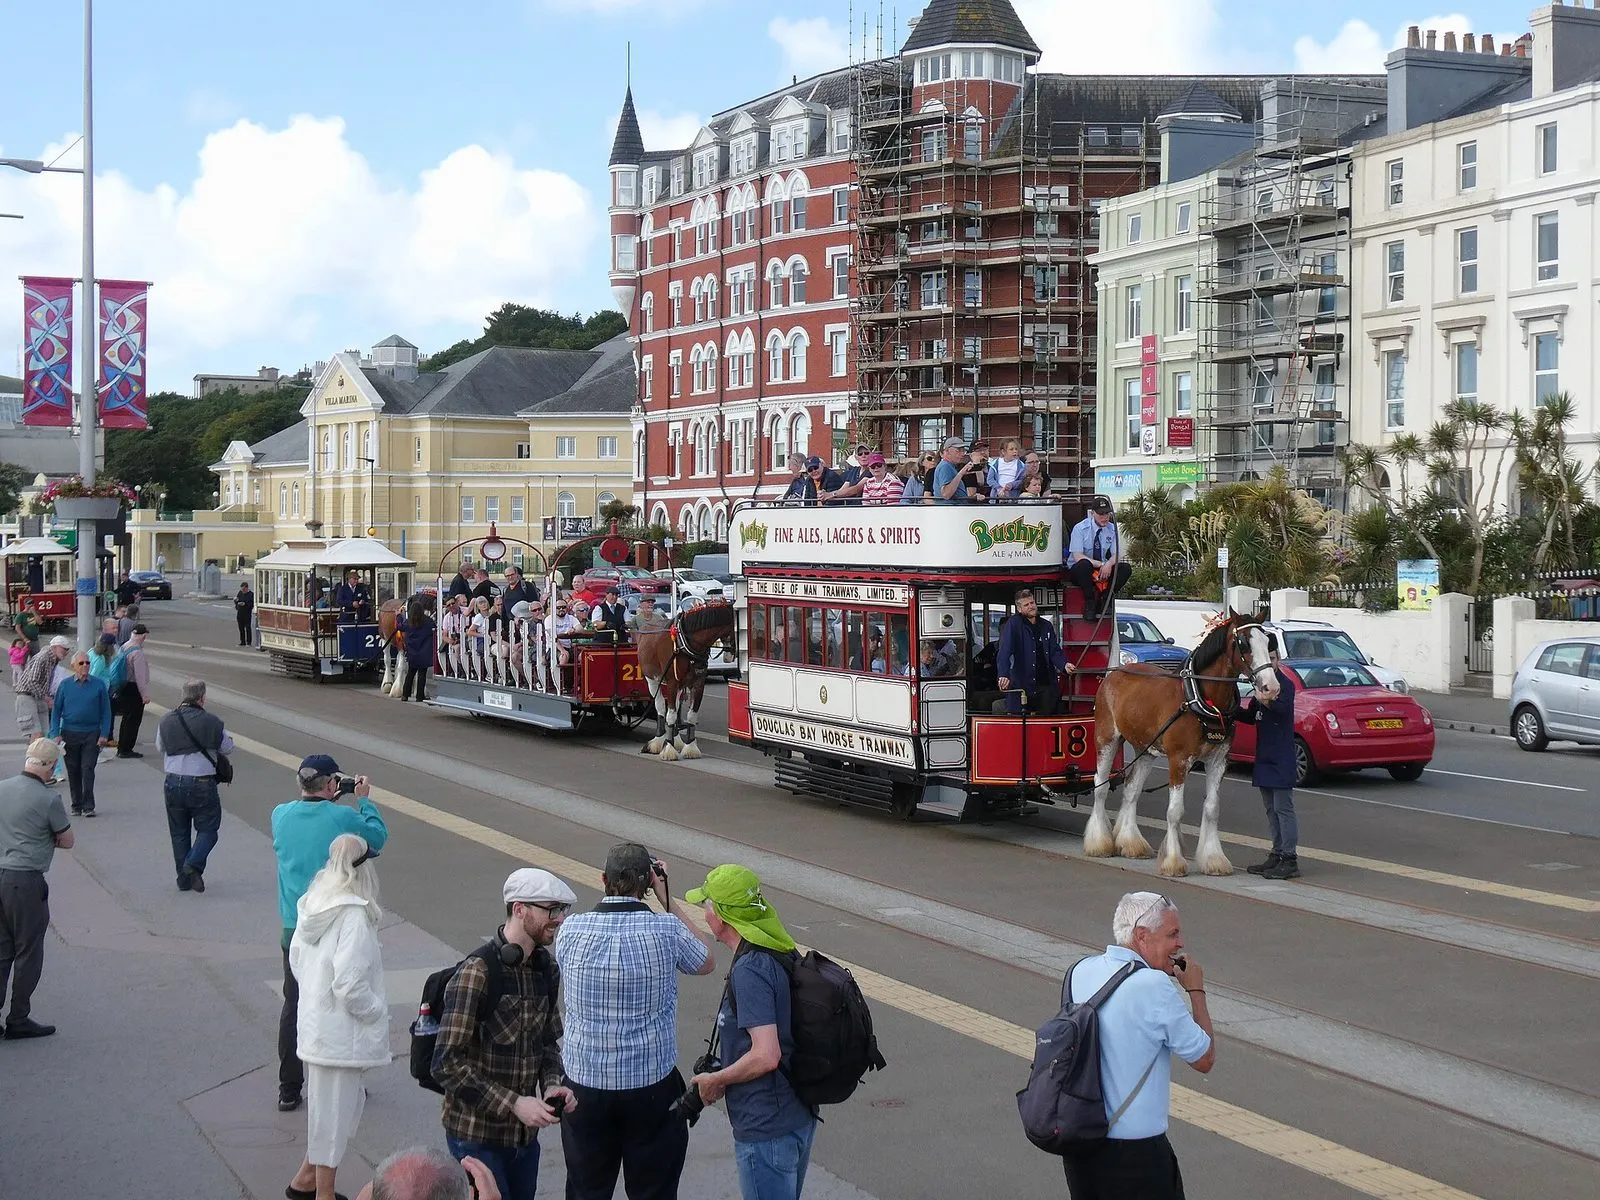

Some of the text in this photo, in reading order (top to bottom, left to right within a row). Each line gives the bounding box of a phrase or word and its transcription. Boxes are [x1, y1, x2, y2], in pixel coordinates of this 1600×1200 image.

[325, 394, 358, 406] VILLA MARINA
[1160, 465, 1173, 475] Taste
[1182, 464, 1201, 476] Bengl
[1100, 474, 1141, 488] MARMARIS
[774, 527, 921, 546] FINE ALES, LAGERS & SPIRITS
[969, 515, 1052, 553] Bushy's
[756, 581, 898, 601] THE ISLE OF MAN TRAMWAYS, LIMITED.
[38, 601, 53, 610] 29
[622, 664, 643, 680] 21
[756, 716, 910, 759] DOUGLAS BAY HORSE TRAMWAY.
[1051, 724, 1088, 759] 18
